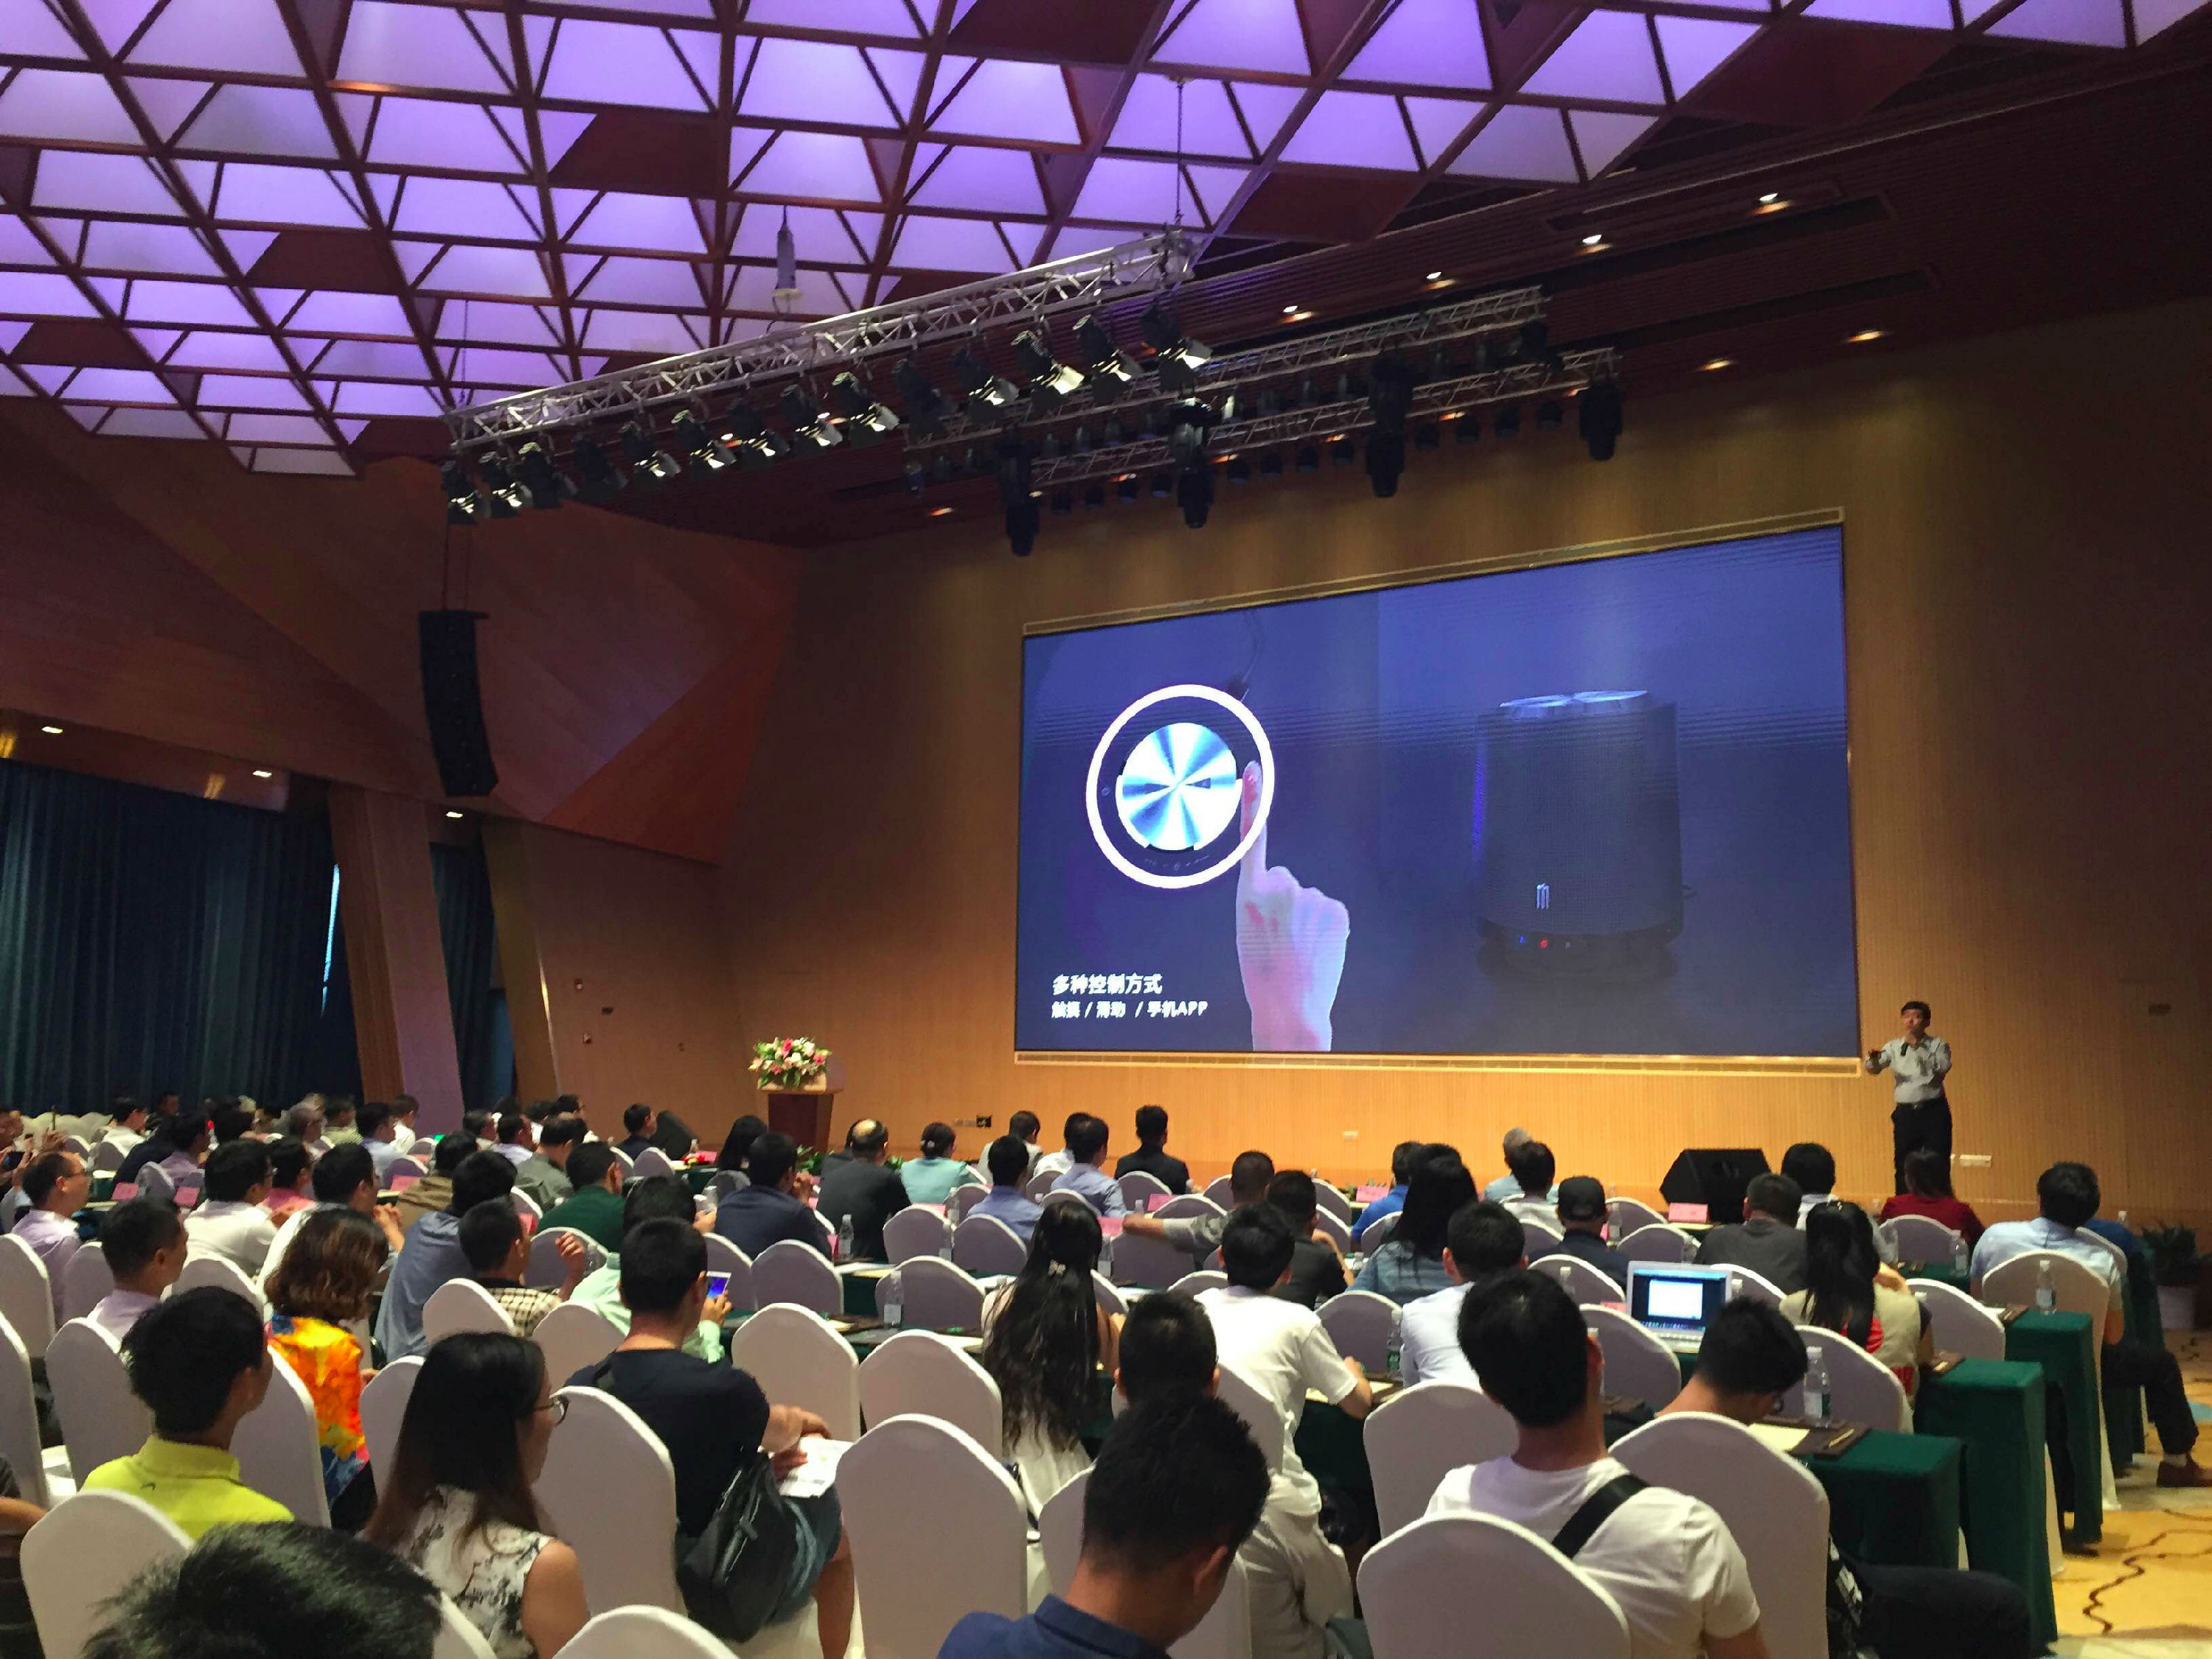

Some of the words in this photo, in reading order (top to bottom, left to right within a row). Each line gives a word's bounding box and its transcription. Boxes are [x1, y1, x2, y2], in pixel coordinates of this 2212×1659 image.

[1052, 973, 1162, 995] 多种控制方式
[1147, 1001, 1208, 1018] 手机APP
